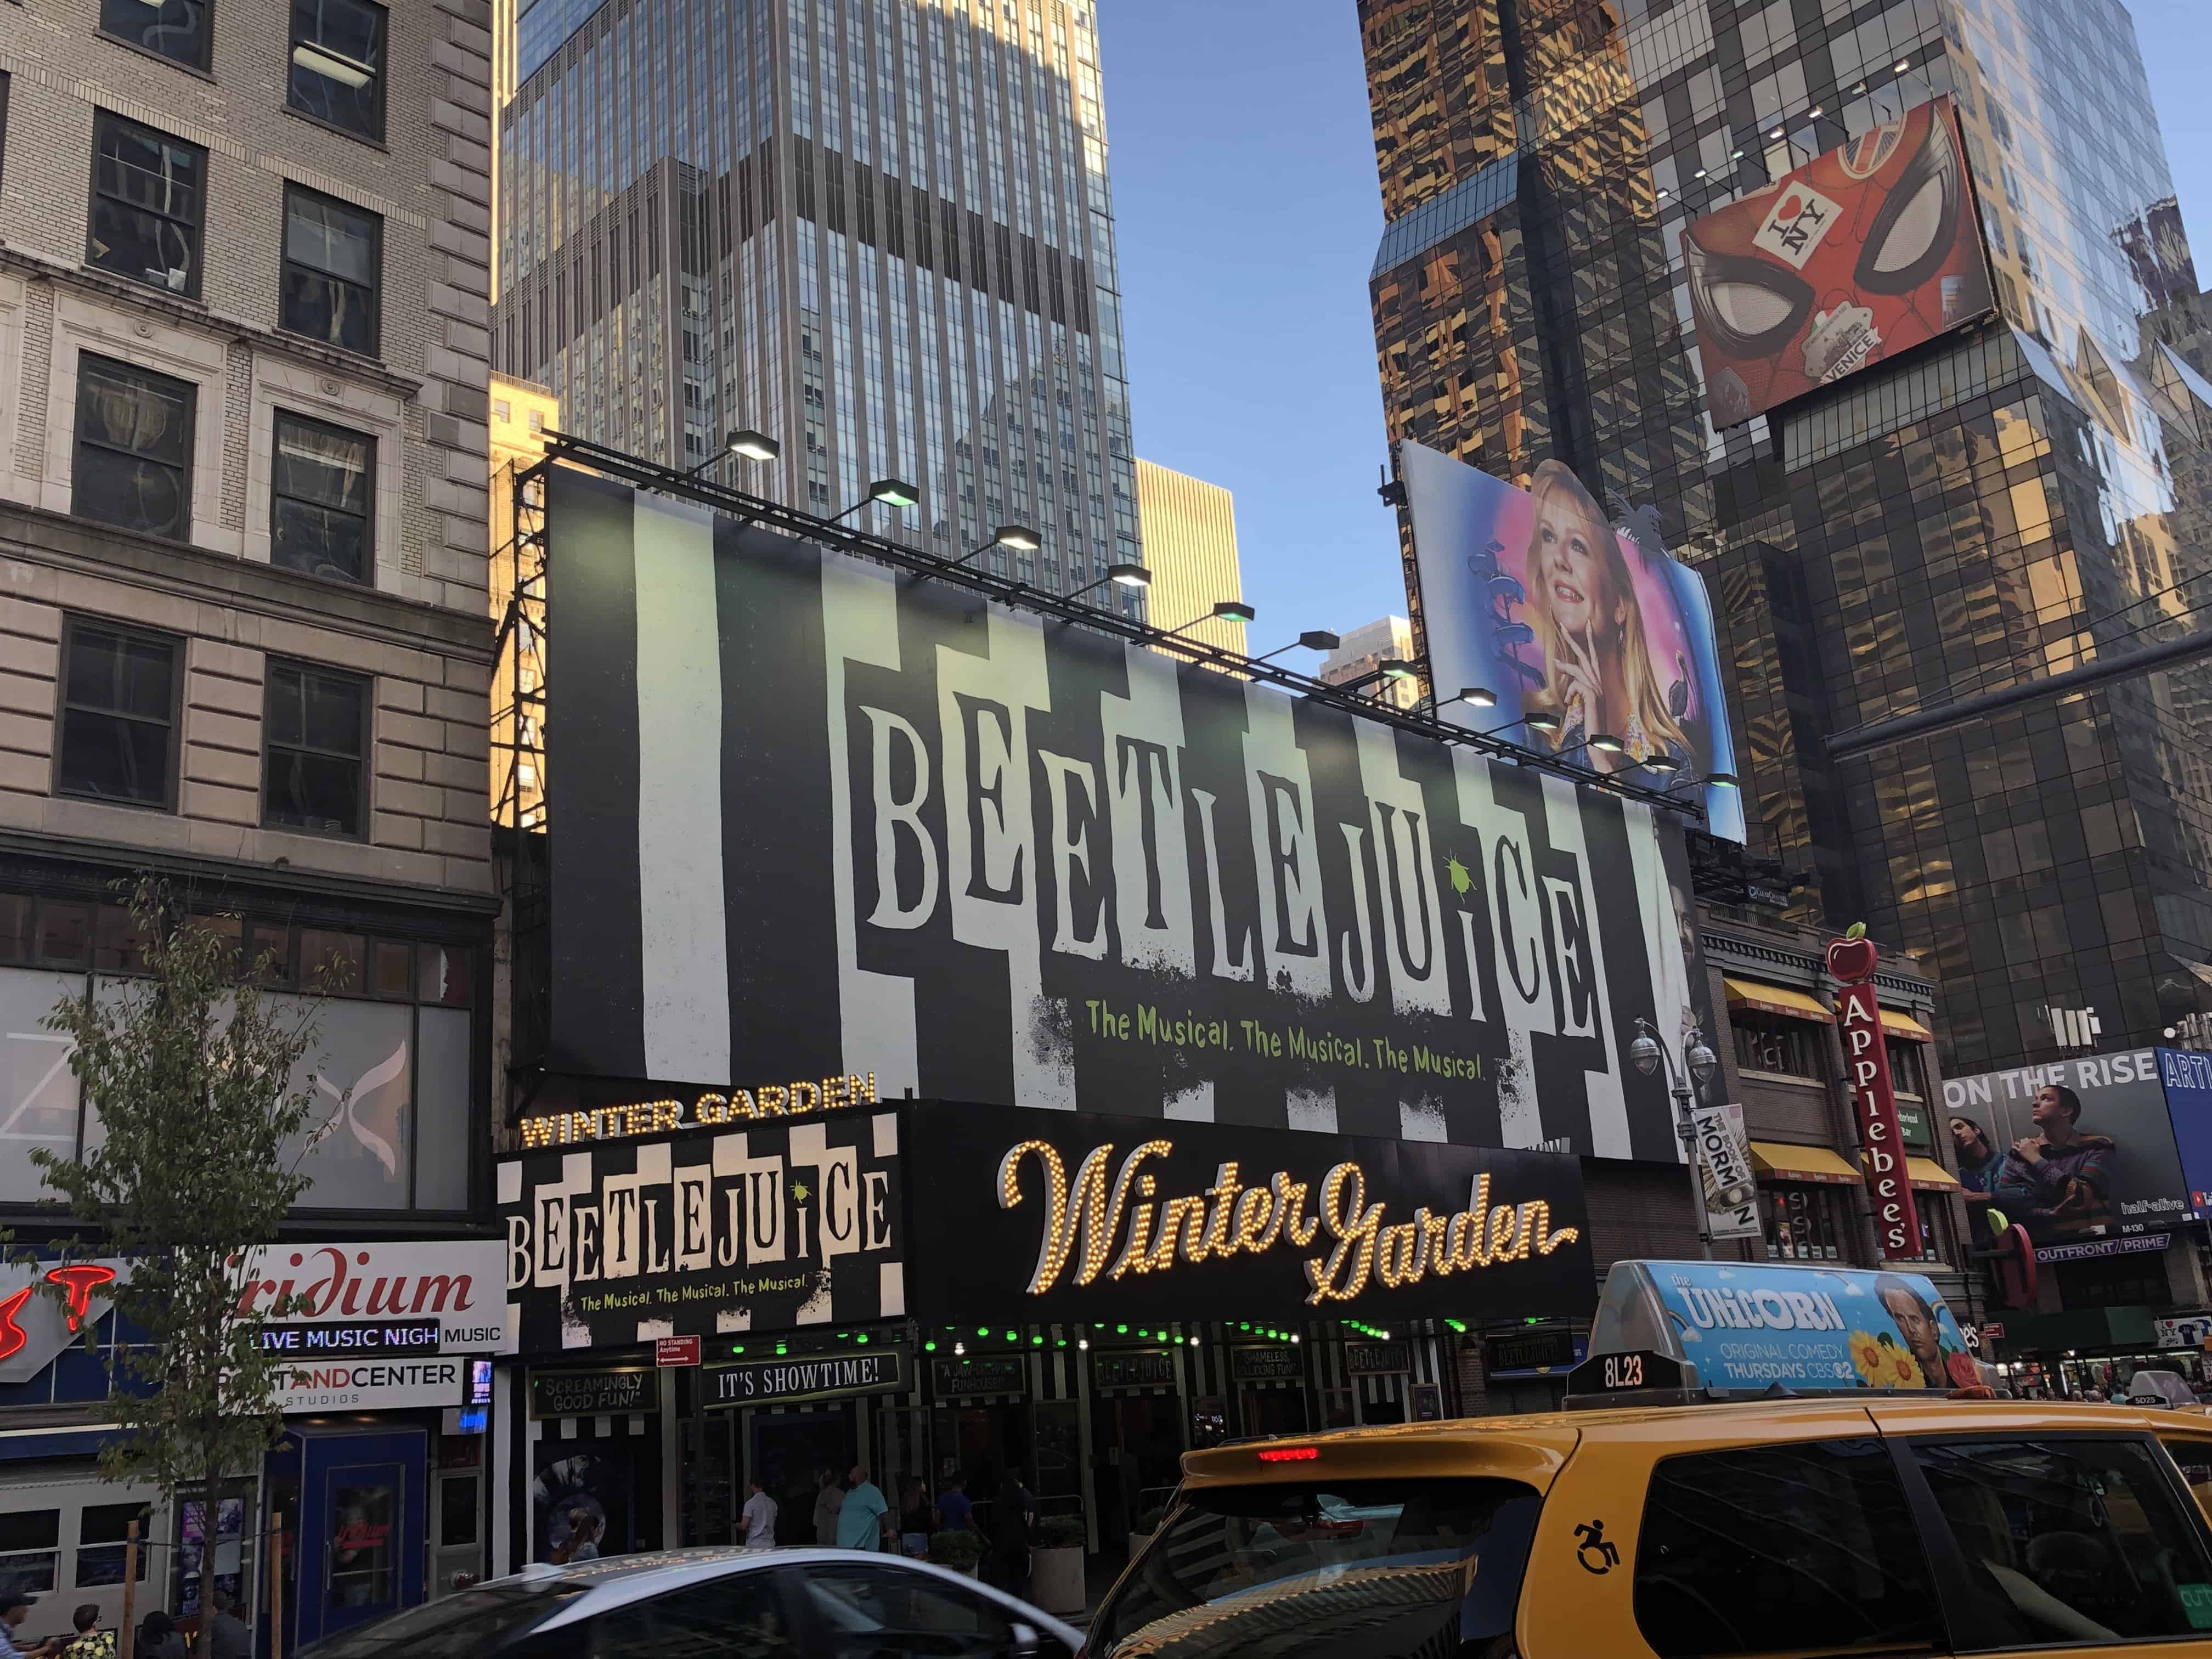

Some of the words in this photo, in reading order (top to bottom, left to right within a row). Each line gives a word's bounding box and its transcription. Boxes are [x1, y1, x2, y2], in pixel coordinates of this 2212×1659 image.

[1781, 199, 1824, 255] NY
[1825, 335, 1874, 380] VENICE
[859, 690, 1595, 1038] BEETLEJUICE
[1086, 1000, 1130, 1041] The
[1138, 1003, 1234, 1052] Musical.
[1240, 1020, 1282, 1058] The
[1289, 1027, 1370, 1069] Musical.
[1374, 1039, 1408, 1073] The
[1413, 1045, 1487, 1081] Musical.
[1943, 1075, 1993, 1108] ON
[1998, 1063, 2068, 1099] THE
[2076, 1052, 2157, 1089] RISE
[521, 1099, 684, 1148] WINTER
[695, 1071, 883, 1124] GARDEN
[1843, 994, 1905, 1249] Applebee's
[1713, 1112, 1726, 1133] THE
[1722, 1134, 1739, 1164] BOOK
[1735, 1165, 1746, 1180] OF
[505, 1160, 891, 1290] BEETLEJUICE
[997, 1139, 1318, 1295] Winter
[1304, 1161, 1578, 1306] Garden
[2037, 1242, 2114, 1261] OUTFRONT
[2124, 1236, 2165, 1251] PRIME
[580, 1296, 601, 1312] The
[604, 1291, 652, 1310] Musical.
[657, 1288, 679, 1304] The
[682, 1282, 730, 1301] Musical.
[733, 1280, 755, 1295] The
[758, 1273, 808, 1291] Musical.
[1672, 1272, 1692, 1286] the
[250, 1331, 300, 1350] LIVE
[306, 1328, 380, 1348] MUSIC
[383, 1327, 438, 1345] NIGH
[445, 1327, 501, 1342] MUSIC
[1720, 1344, 1787, 1359] ORIGINAL
[1788, 1344, 1844, 1359] COMEDY
[718, 1372, 754, 1399] IT'S
[764, 1357, 880, 1394] SHOWTIME!
[1605, 1355, 1642, 1388] 8L23
[1724, 1362, 1807, 1379] THURSDAYS
[285, 1393, 360, 1406] STUDIOS
[554, 1395, 593, 1412] GOOD
